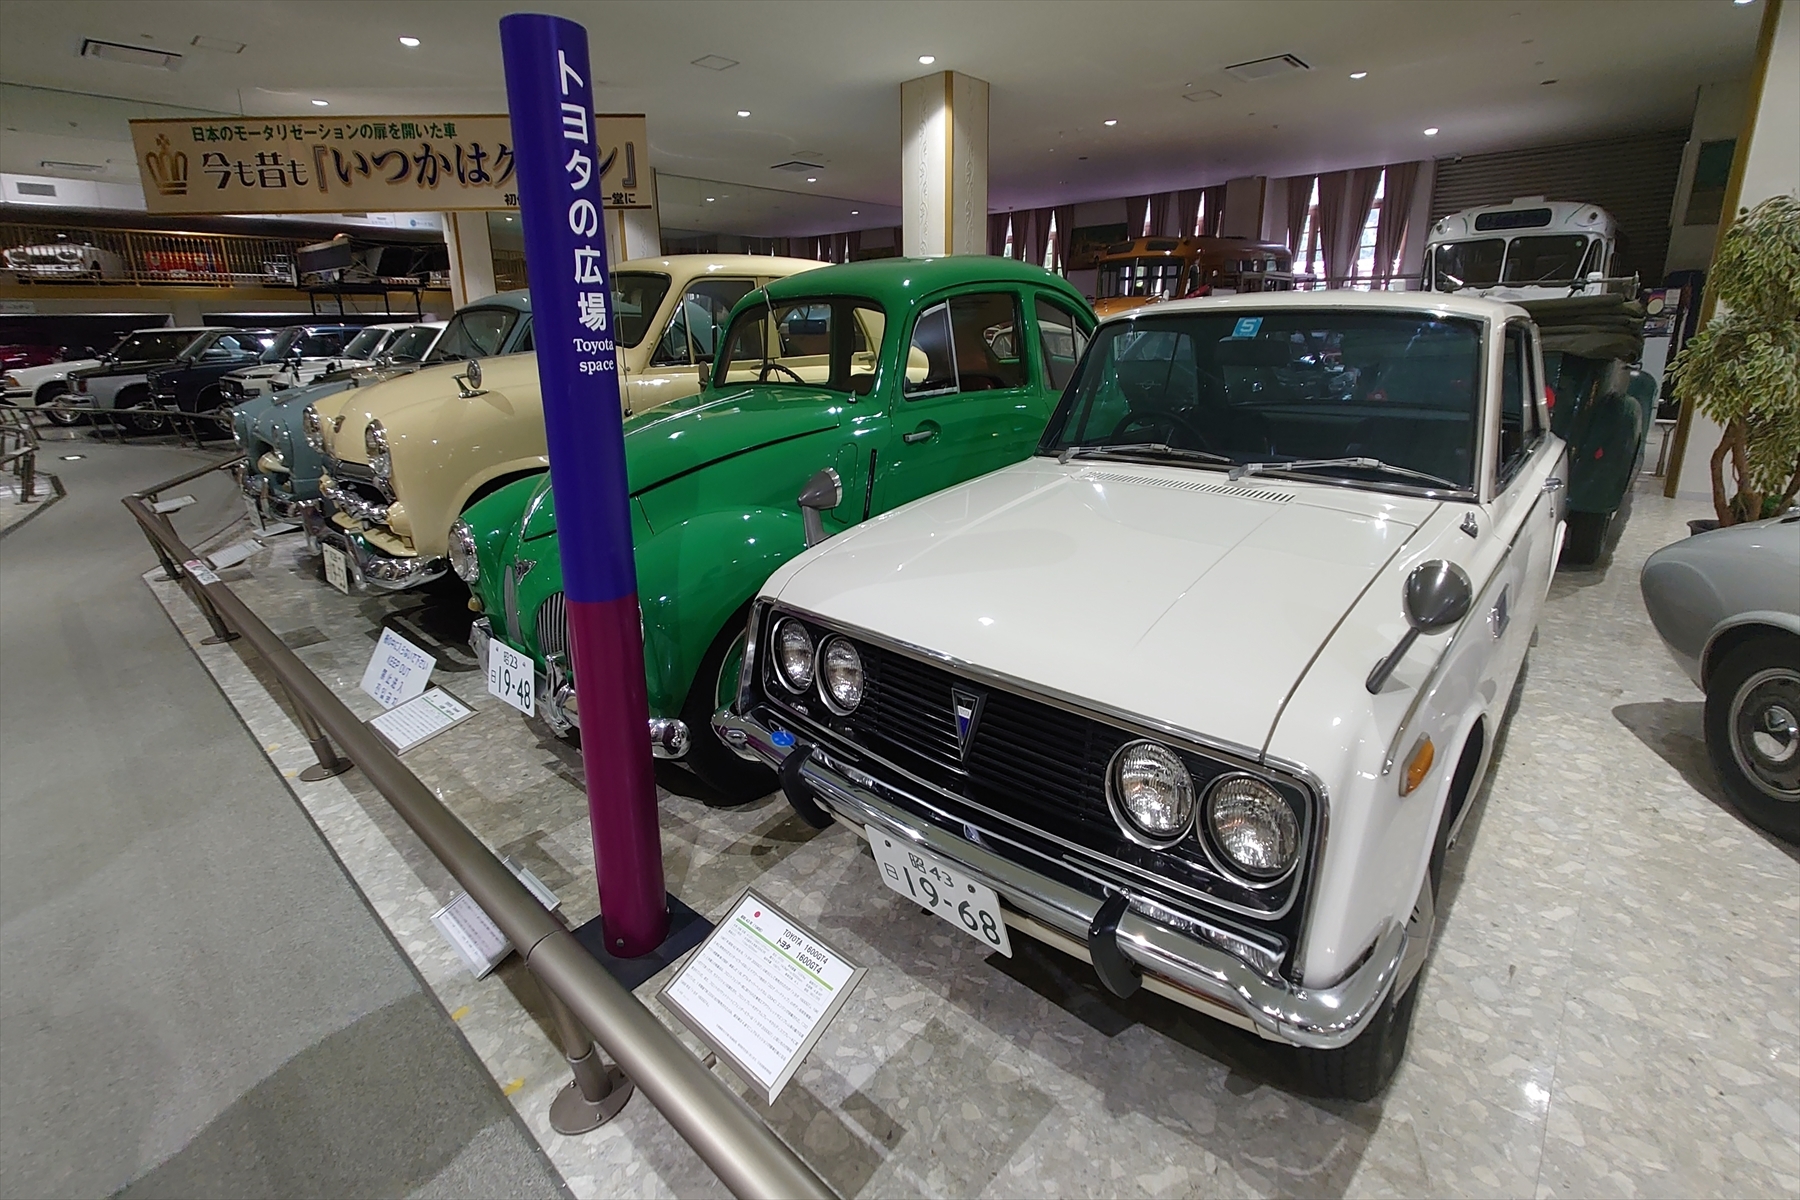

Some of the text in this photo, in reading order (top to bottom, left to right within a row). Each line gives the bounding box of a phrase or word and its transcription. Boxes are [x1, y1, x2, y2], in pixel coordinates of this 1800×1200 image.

[191, 122, 458, 143] 日本のモータリゼーションの扉を開いた車
[557, 49, 607, 332] トヨタの広場
[573, 337, 614, 356] Toyota
[579, 358, 614, 376] space
[498, 665, 531, 710] 19-48
[907, 851, 955, 888] 昭43
[883, 862, 1001, 946] 日 19-68
[775, 937, 823, 975] トヨタ 1600GT4
[782, 928, 829, 965] TOYOTA 1600GT4
